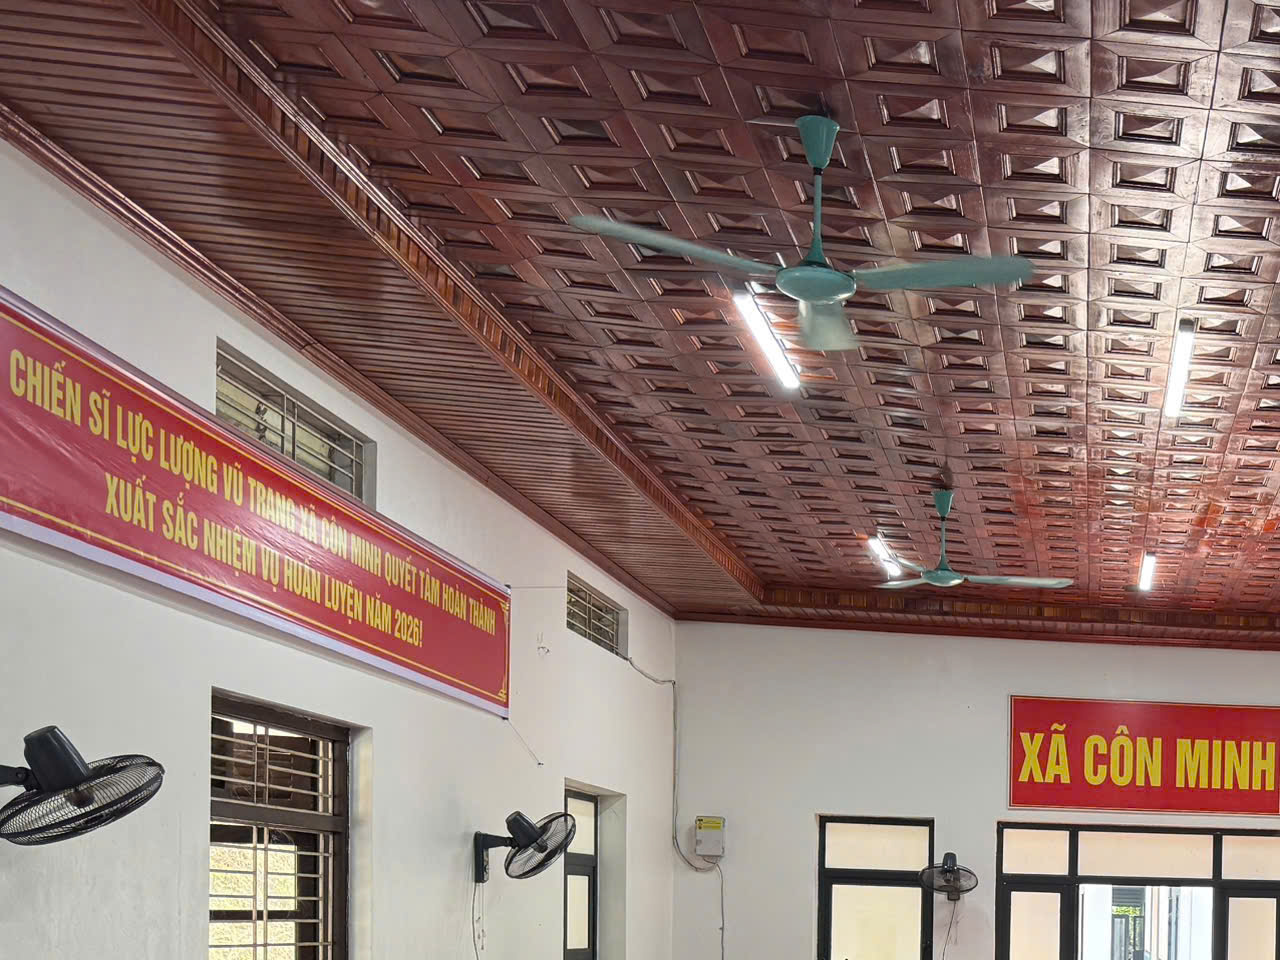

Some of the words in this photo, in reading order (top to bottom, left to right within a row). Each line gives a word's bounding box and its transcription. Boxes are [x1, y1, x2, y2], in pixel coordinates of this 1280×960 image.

[9, 348, 82, 427] CHIẾN
[88, 388, 111, 441] SĨ
[116, 404, 154, 463] LỰC
[159, 428, 218, 495] LƯỢNG
[223, 461, 243, 506] VŨ
[247, 476, 296, 534] TRANG
[299, 503, 317, 544] XÃ
[321, 515, 347, 560] CÔN
[350, 532, 382, 577] MINH
[384, 552, 417, 595] QUYẾT
[419, 567, 440, 608] TÂM
[442, 583, 467, 621] HOÀN
[469, 597, 496, 636] THÀNH
[105, 471, 156, 533] XUẤT
[162, 491, 198, 551] SẮC
[203, 518, 256, 577] NHIỆM
[261, 546, 280, 593] VỤ
[284, 554, 321, 604] HUẤN
[324, 574, 363, 625] LUYỆN
[366, 592, 392, 634] NĂM
[394, 608, 423, 648] 2026!
[1017, 723, 1071, 784] XÃ
[1083, 724, 1163, 787] CÔN
[1175, 738, 1276, 791] MINH
